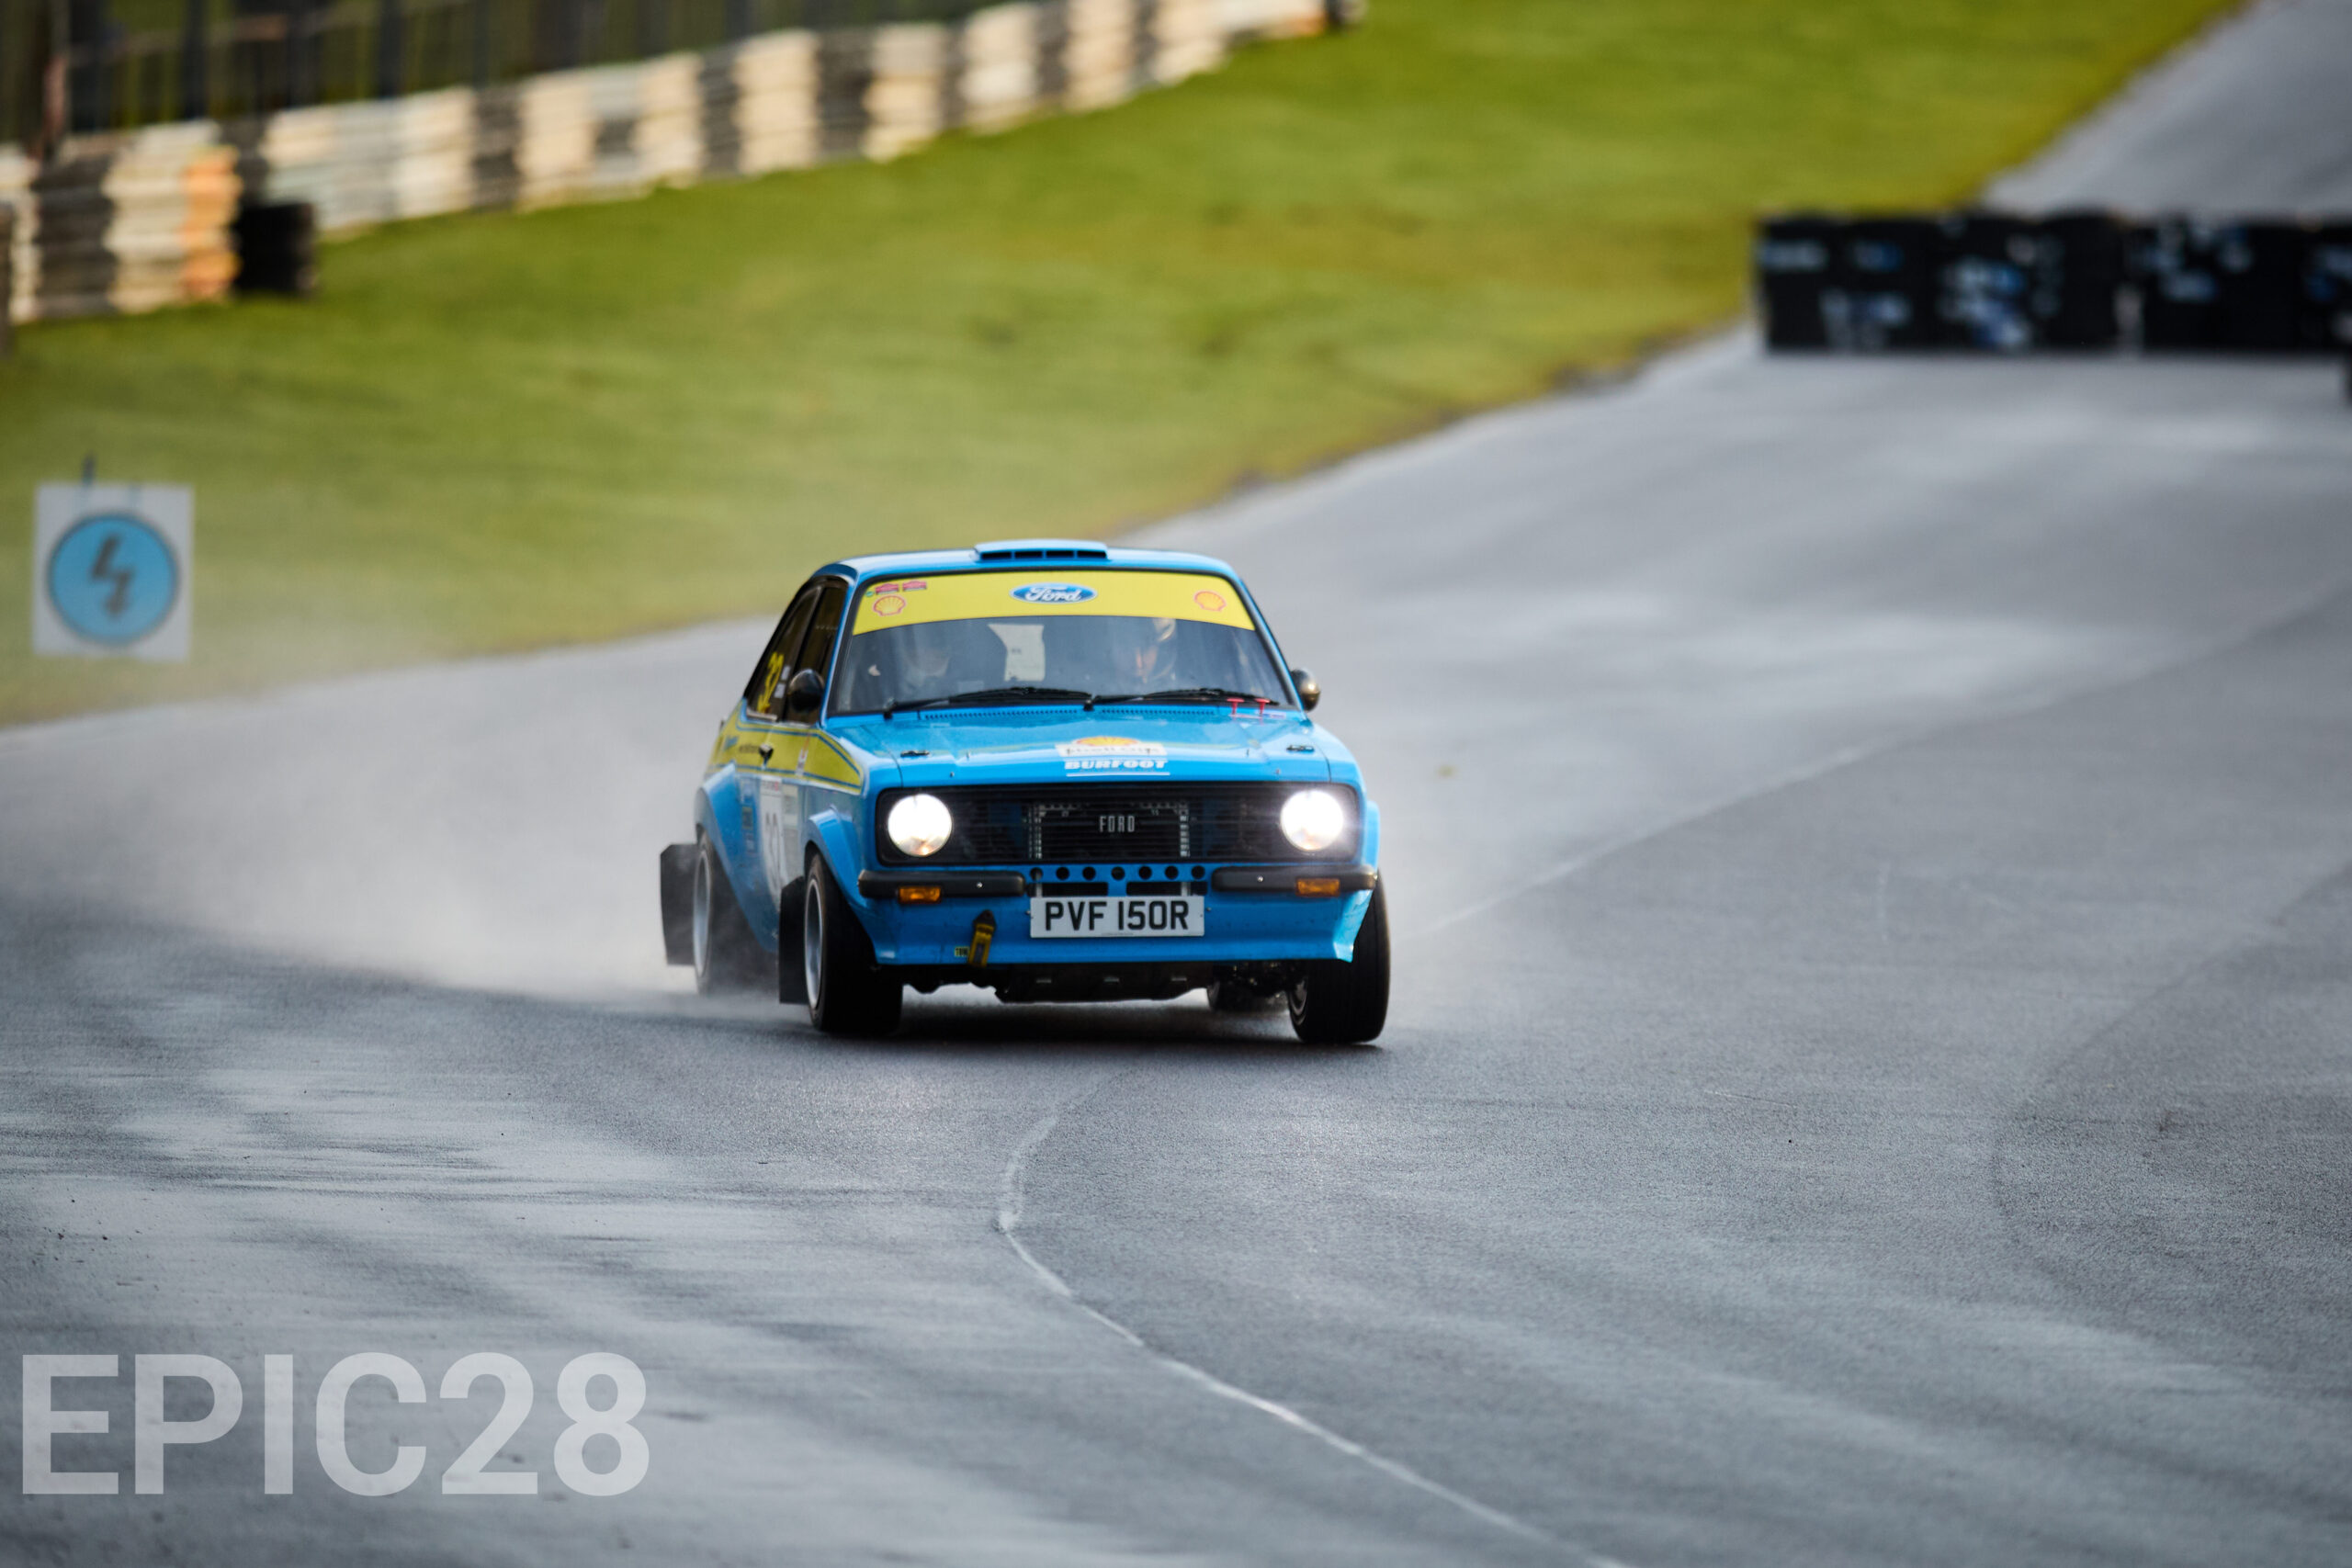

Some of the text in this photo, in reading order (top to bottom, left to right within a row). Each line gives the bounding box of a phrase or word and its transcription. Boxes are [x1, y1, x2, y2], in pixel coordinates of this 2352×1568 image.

[1024, 585, 1082, 603] Ford
[1099, 815, 1136, 832] FORD
[1045, 900, 1189, 931] PVF 150R
